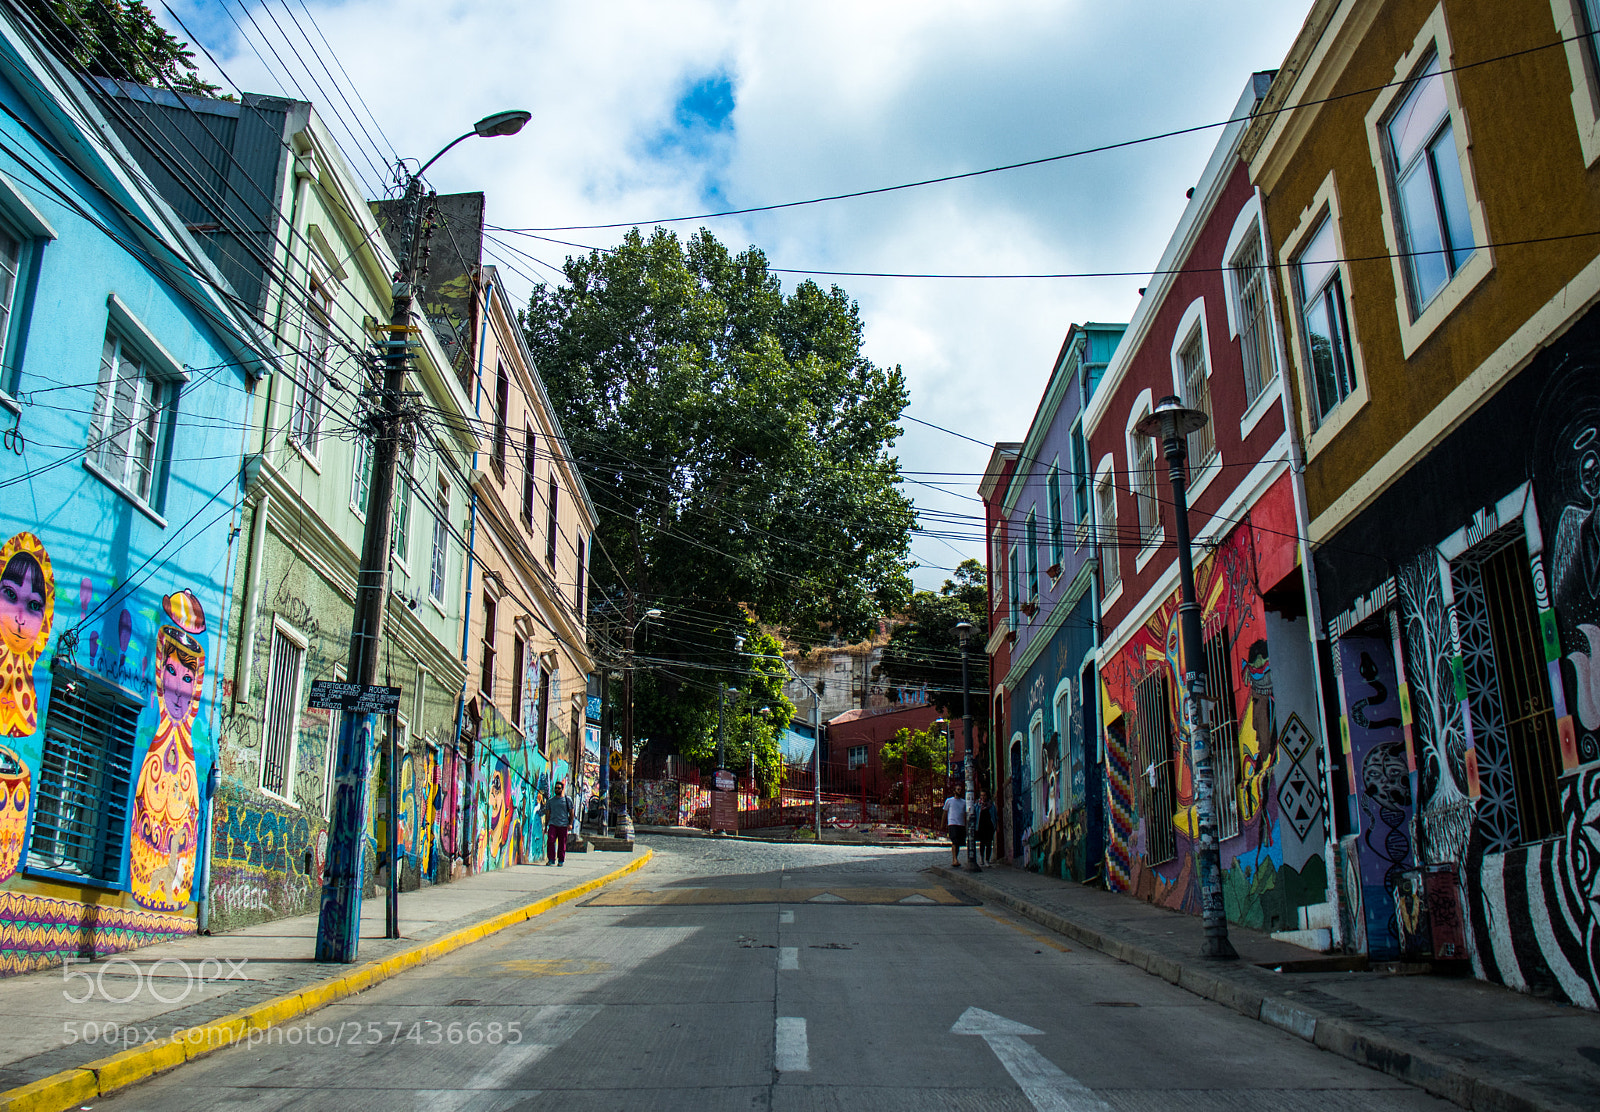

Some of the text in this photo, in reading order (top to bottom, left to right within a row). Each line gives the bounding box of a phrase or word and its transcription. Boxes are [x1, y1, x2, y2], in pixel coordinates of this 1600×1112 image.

[368, 686, 390, 695] ROOMS
[312, 701, 342, 710] TERRAZA
[356, 701, 386, 710] TERRACE
